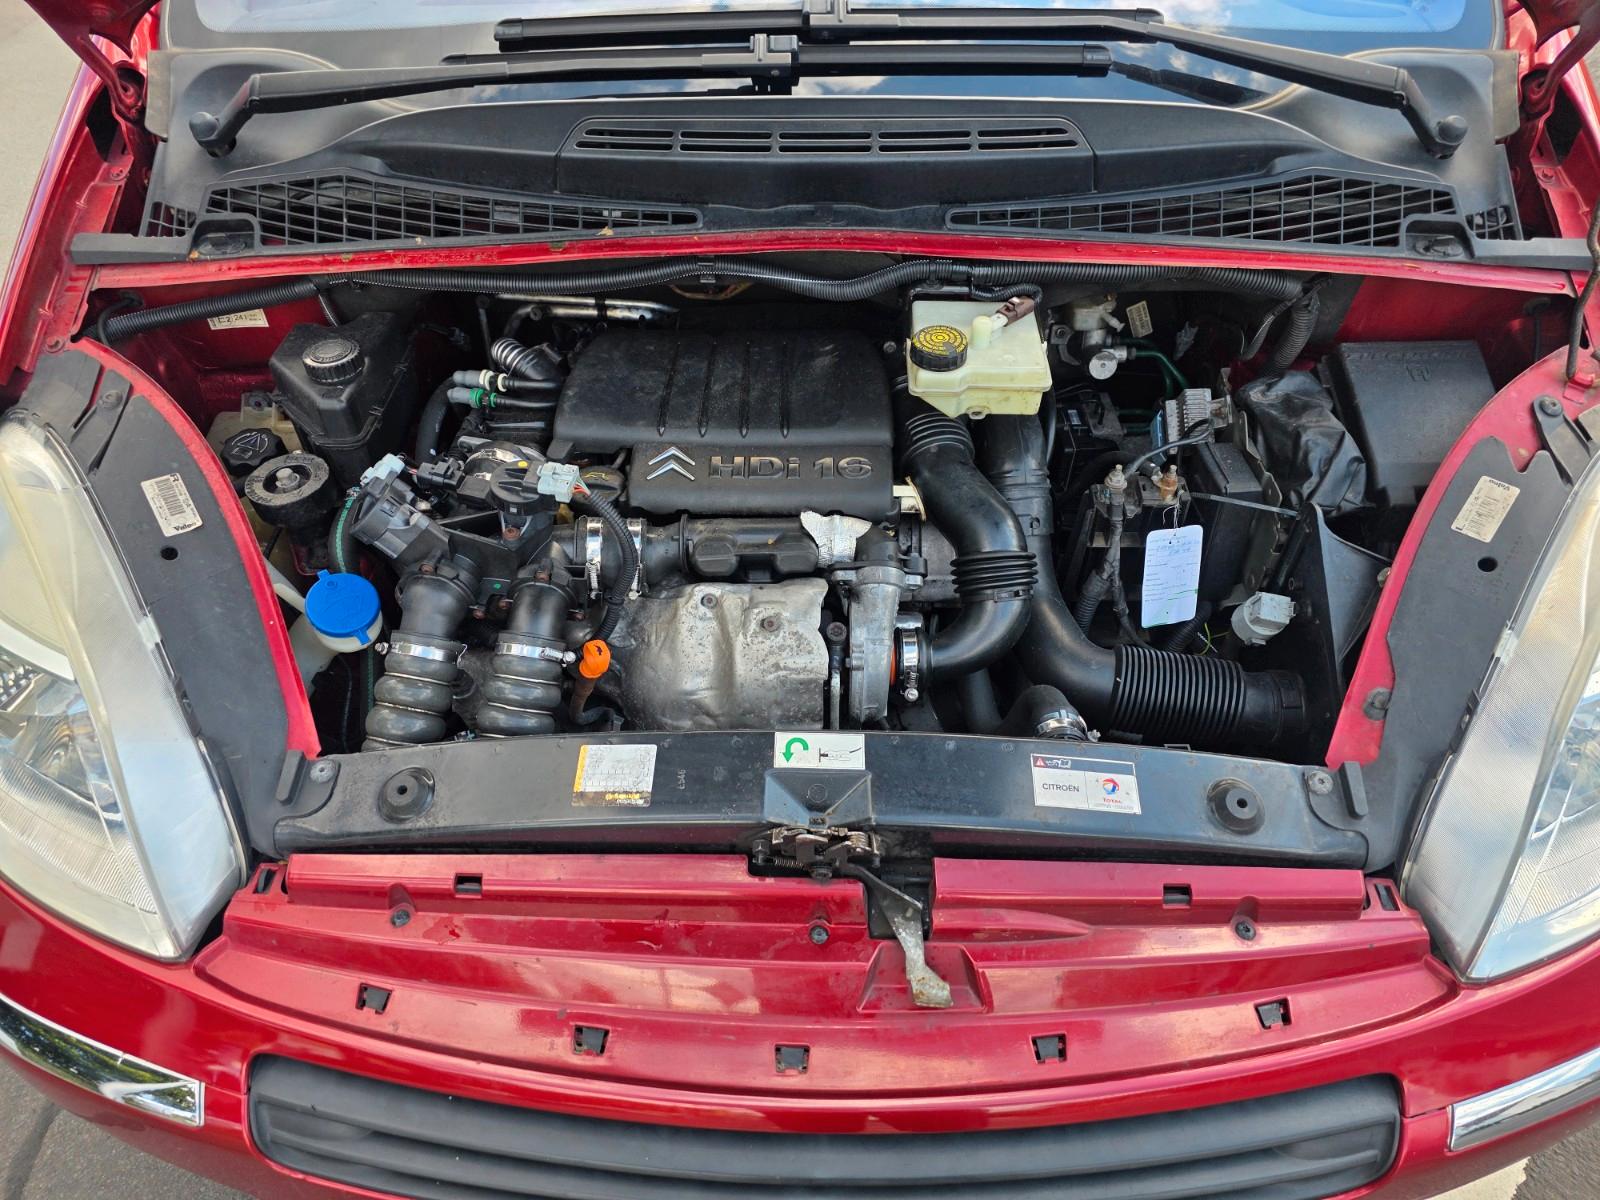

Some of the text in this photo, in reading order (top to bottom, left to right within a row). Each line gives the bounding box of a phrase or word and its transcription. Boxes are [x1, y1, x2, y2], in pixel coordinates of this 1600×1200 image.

[709, 456, 873, 479] HDi 16
[1489, 478, 1511, 491] Valeo
[173, 522, 197, 532] Valeo
[1041, 783, 1080, 792] CITROËN
